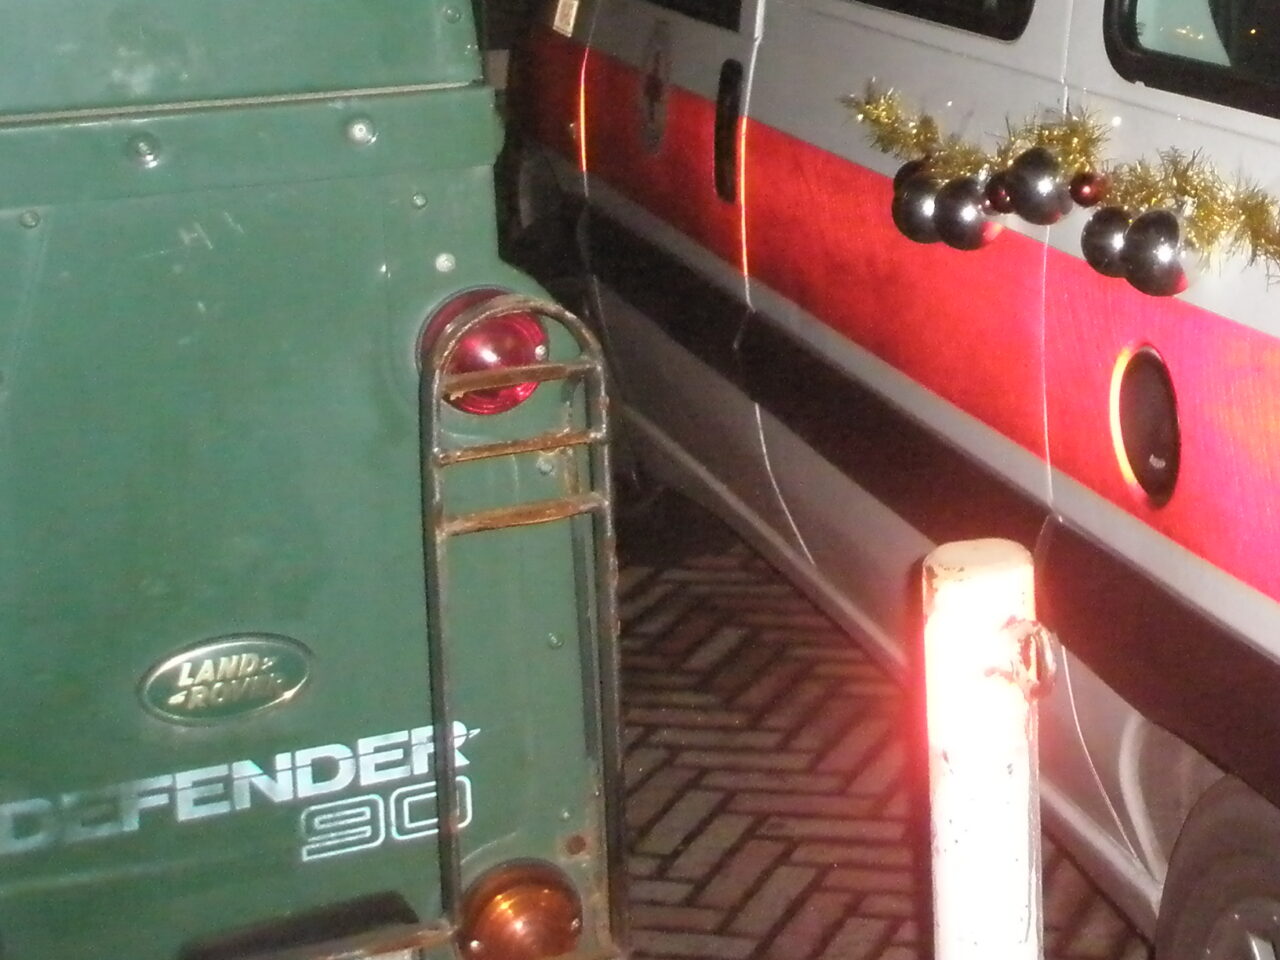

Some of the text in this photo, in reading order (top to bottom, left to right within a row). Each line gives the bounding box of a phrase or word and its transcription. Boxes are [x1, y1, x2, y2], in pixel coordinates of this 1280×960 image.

[177, 652, 261, 688] LAND
[0, 720, 471, 855] DEFENDER
[301, 775, 473, 862] 90
